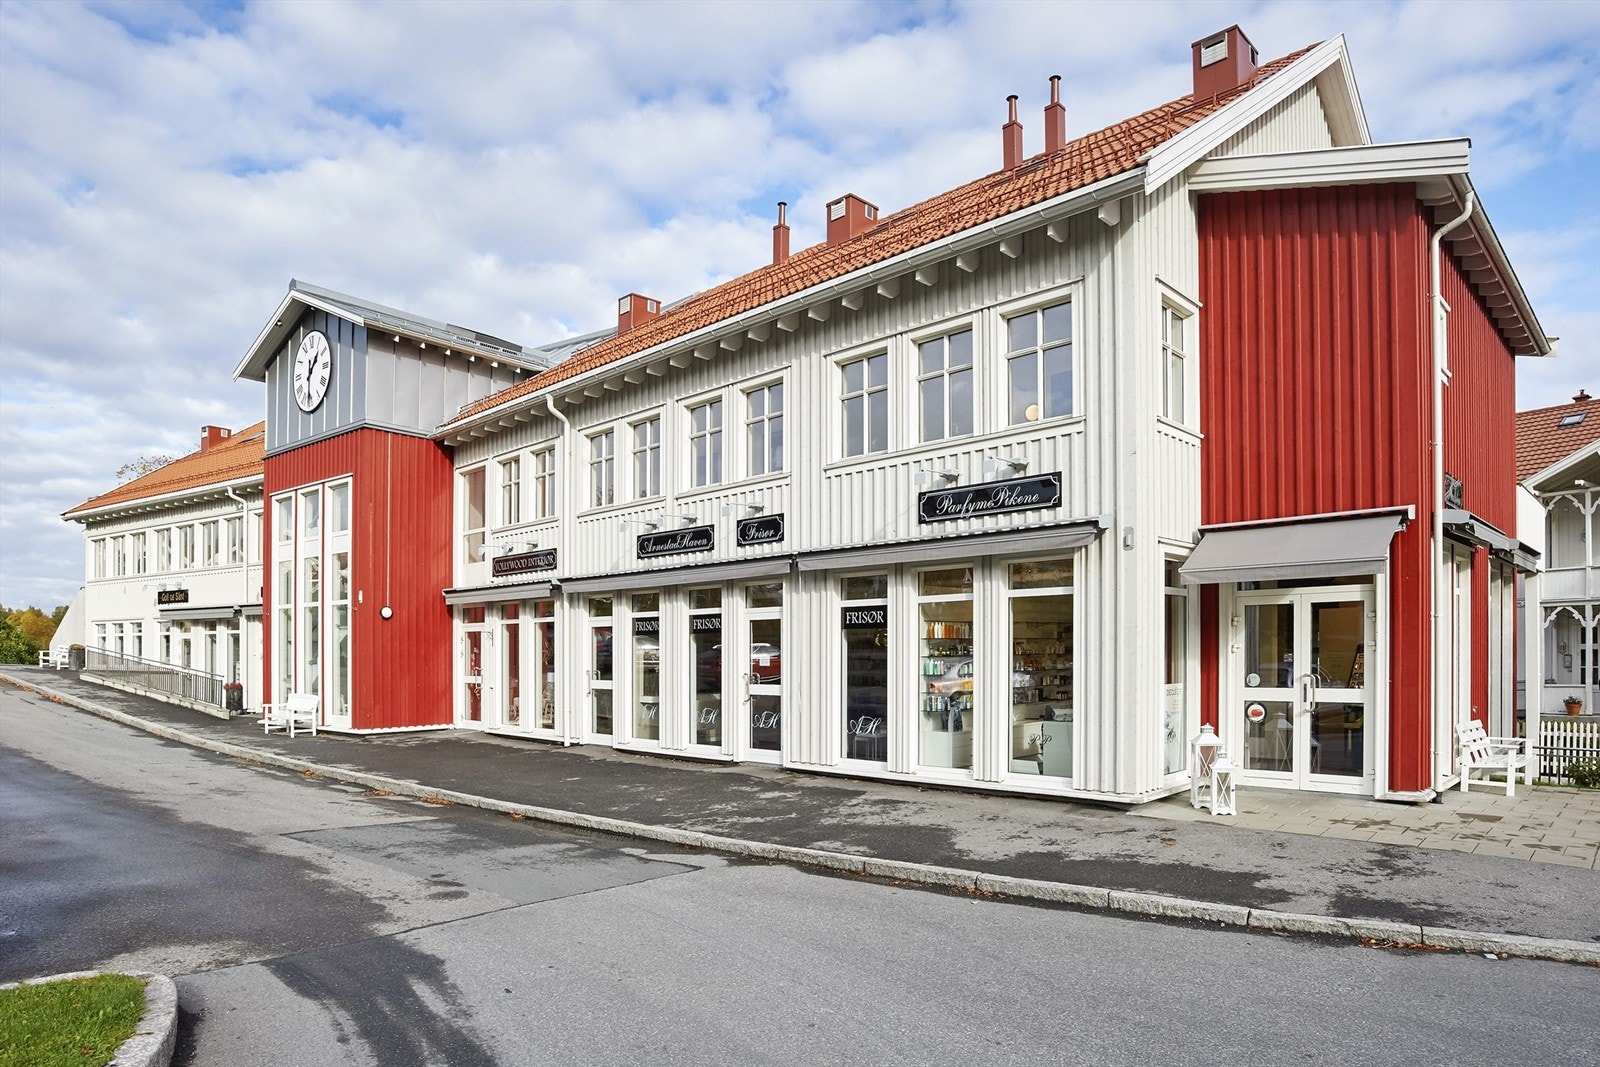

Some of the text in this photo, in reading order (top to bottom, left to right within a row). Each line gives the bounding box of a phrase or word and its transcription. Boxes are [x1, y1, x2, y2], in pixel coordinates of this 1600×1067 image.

[845, 610, 884, 624] FRISØR
[635, 621, 659, 632] FRISØR
[693, 618, 721, 630] FRISØR
